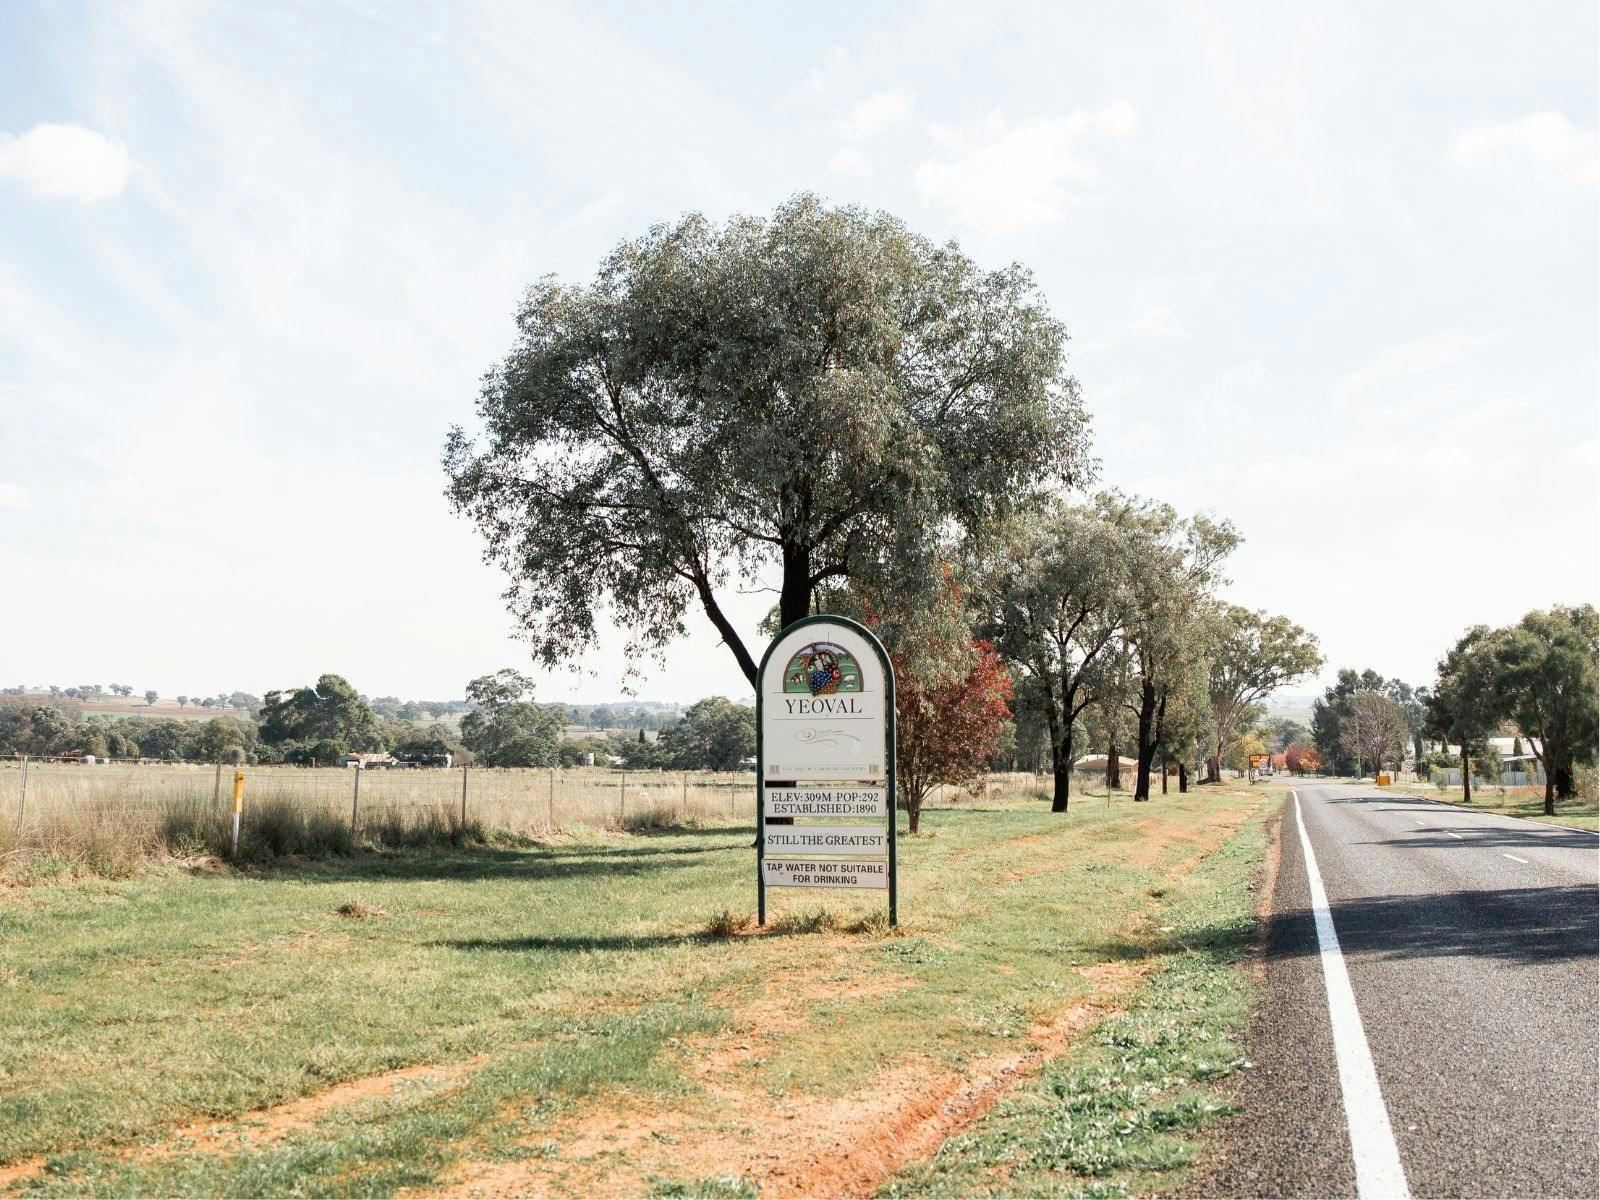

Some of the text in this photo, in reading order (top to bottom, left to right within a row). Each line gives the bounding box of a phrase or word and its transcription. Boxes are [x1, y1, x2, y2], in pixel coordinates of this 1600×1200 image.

[785, 699, 862, 714] YEOVAL
[771, 793, 879, 802] ELEV:309M POP:292
[774, 804, 877, 814] ESTABLISHED:1890
[768, 835, 883, 846] STILL THE GREATEST
[767, 863, 883, 874] TAP WATER NOT SUITABLE
[793, 875, 857, 884] FOR DRINKING
